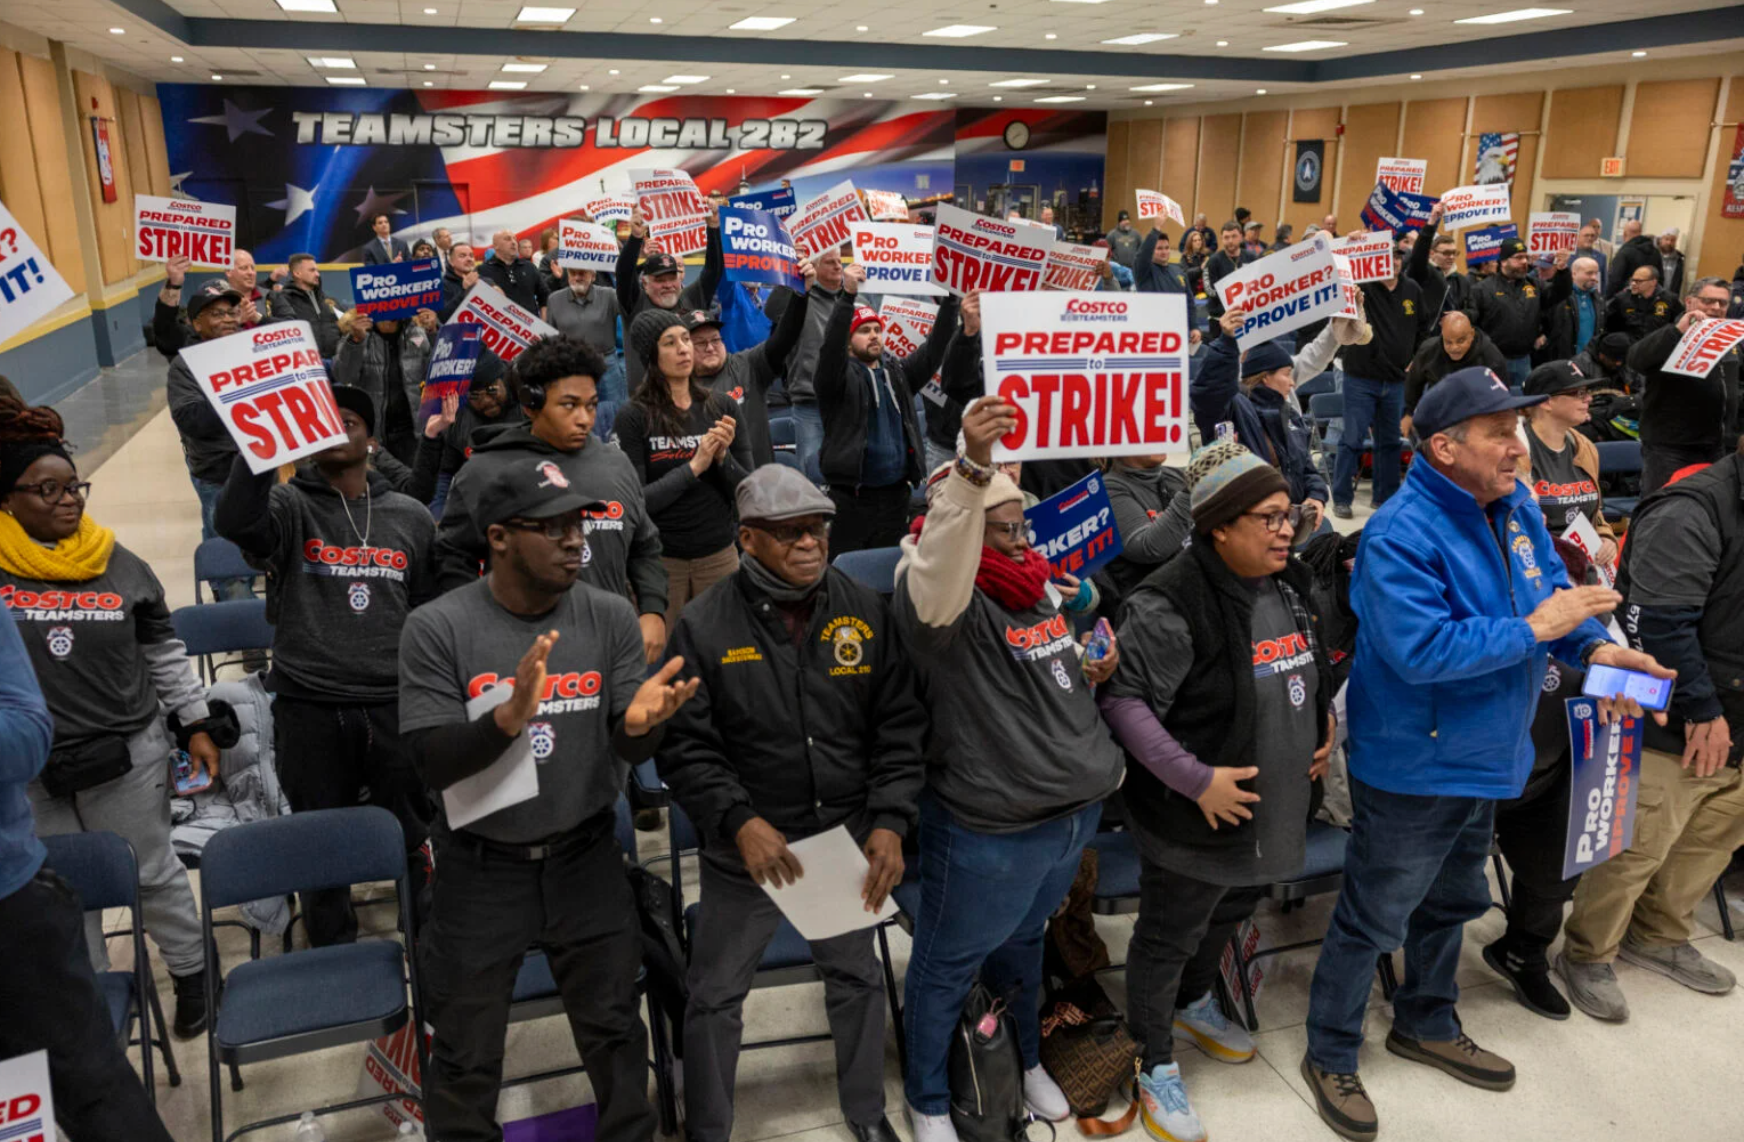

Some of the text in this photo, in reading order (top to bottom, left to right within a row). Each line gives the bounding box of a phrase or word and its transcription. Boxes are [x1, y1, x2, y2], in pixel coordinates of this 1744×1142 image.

[292, 111, 828, 150] TEAMSTERS LOCAL 282
[1380, 166, 1424, 174] PREPARED
[790, 192, 856, 236] PREPARED
[1446, 197, 1507, 212] WORKER?
[1491, 207, 1507, 216] IT!
[139, 210, 232, 230] PREPARED
[724, 216, 769, 237] PRO
[976, 218, 1017, 235] COSTCO
[562, 227, 591, 240] PRO
[856, 232, 899, 249] PRO
[938, 223, 1046, 261] PREPARED
[139, 227, 232, 266] STRIKE!
[566, 249, 606, 262] PROVE
[735, 253, 790, 275] PROVE
[356, 273, 397, 289] PRO
[361, 278, 441, 300] WORKER?
[1224, 273, 1275, 306] PRO
[1240, 265, 1334, 313] WORKER?
[421, 291, 440, 304] IT!
[1314, 283, 1339, 306] IT!
[1066, 299, 1128, 314] COSTCO
[253, 327, 302, 346] COSTCO
[994, 331, 1182, 356] PREPARED
[1089, 358, 1103, 370] to
[295, 370, 308, 381] to
[997, 372, 1182, 451] STRIKE!
[303, 538, 408, 570] COSTCO
[329, 565, 405, 582] TEAMSTERS
[24, 609, 125, 621] TEAMSTERS
[1626, 604, 1641, 634] 570
[821, 615, 874, 641] TEAMSTERS
[829, 665, 858, 676] LOCAL
[1575, 787, 1601, 864] PRO
